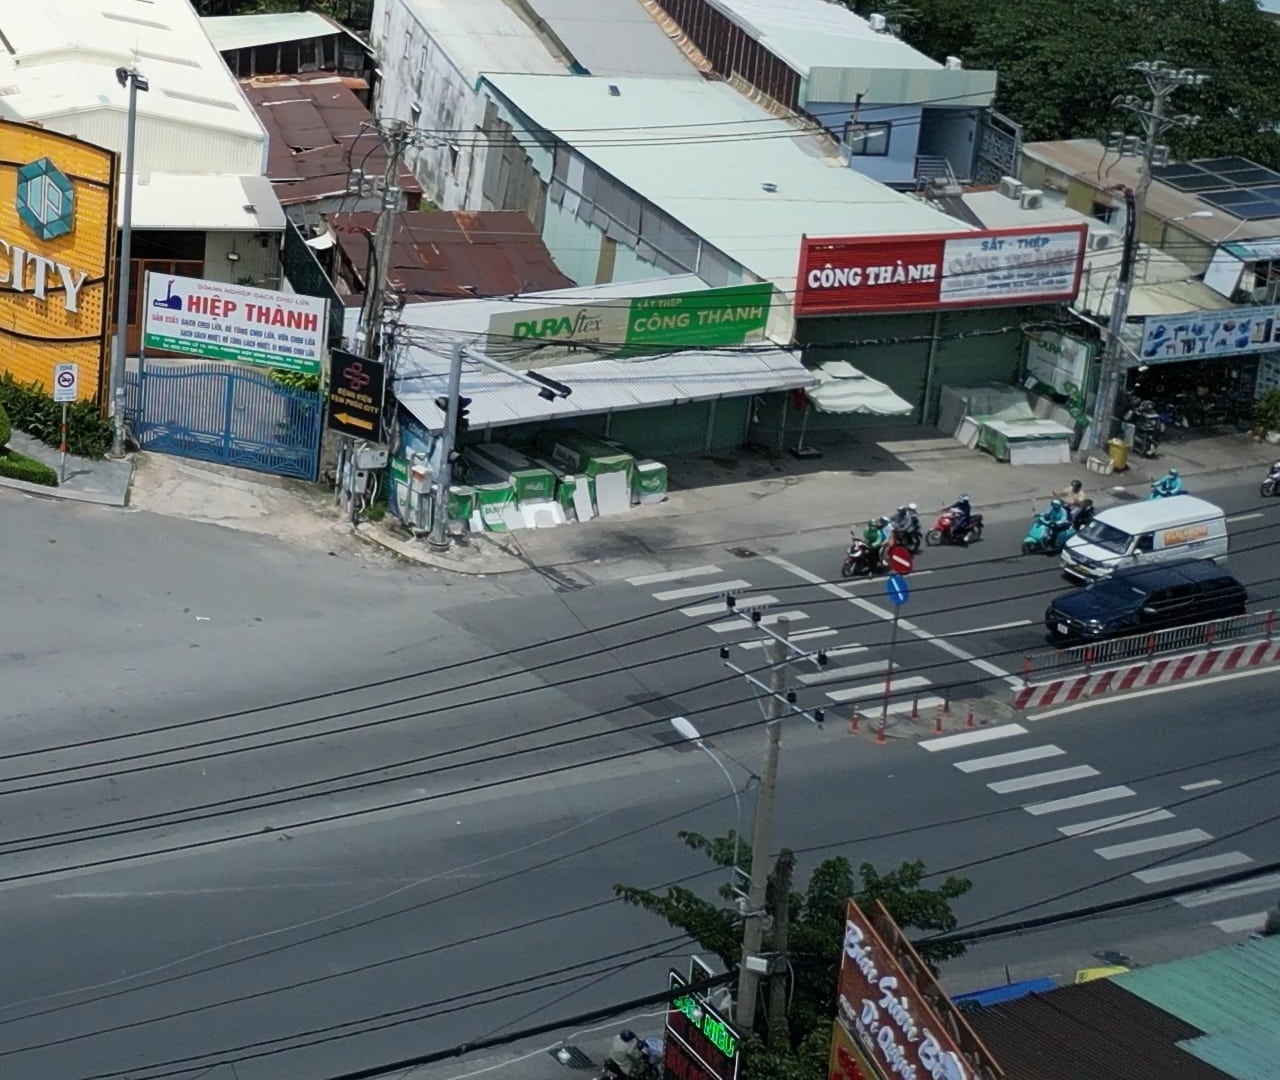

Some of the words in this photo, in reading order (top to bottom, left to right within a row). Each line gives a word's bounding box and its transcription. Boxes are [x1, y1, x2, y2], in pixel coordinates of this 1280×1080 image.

[808, 263, 862, 289] CÔNG
[866, 259, 937, 286] THÀNH
[187, 294, 238, 320] HIỆP
[245, 303, 318, 332] THÀNH
[634, 311, 690, 333] CÔNG
[697, 301, 764, 325] THÀNH
